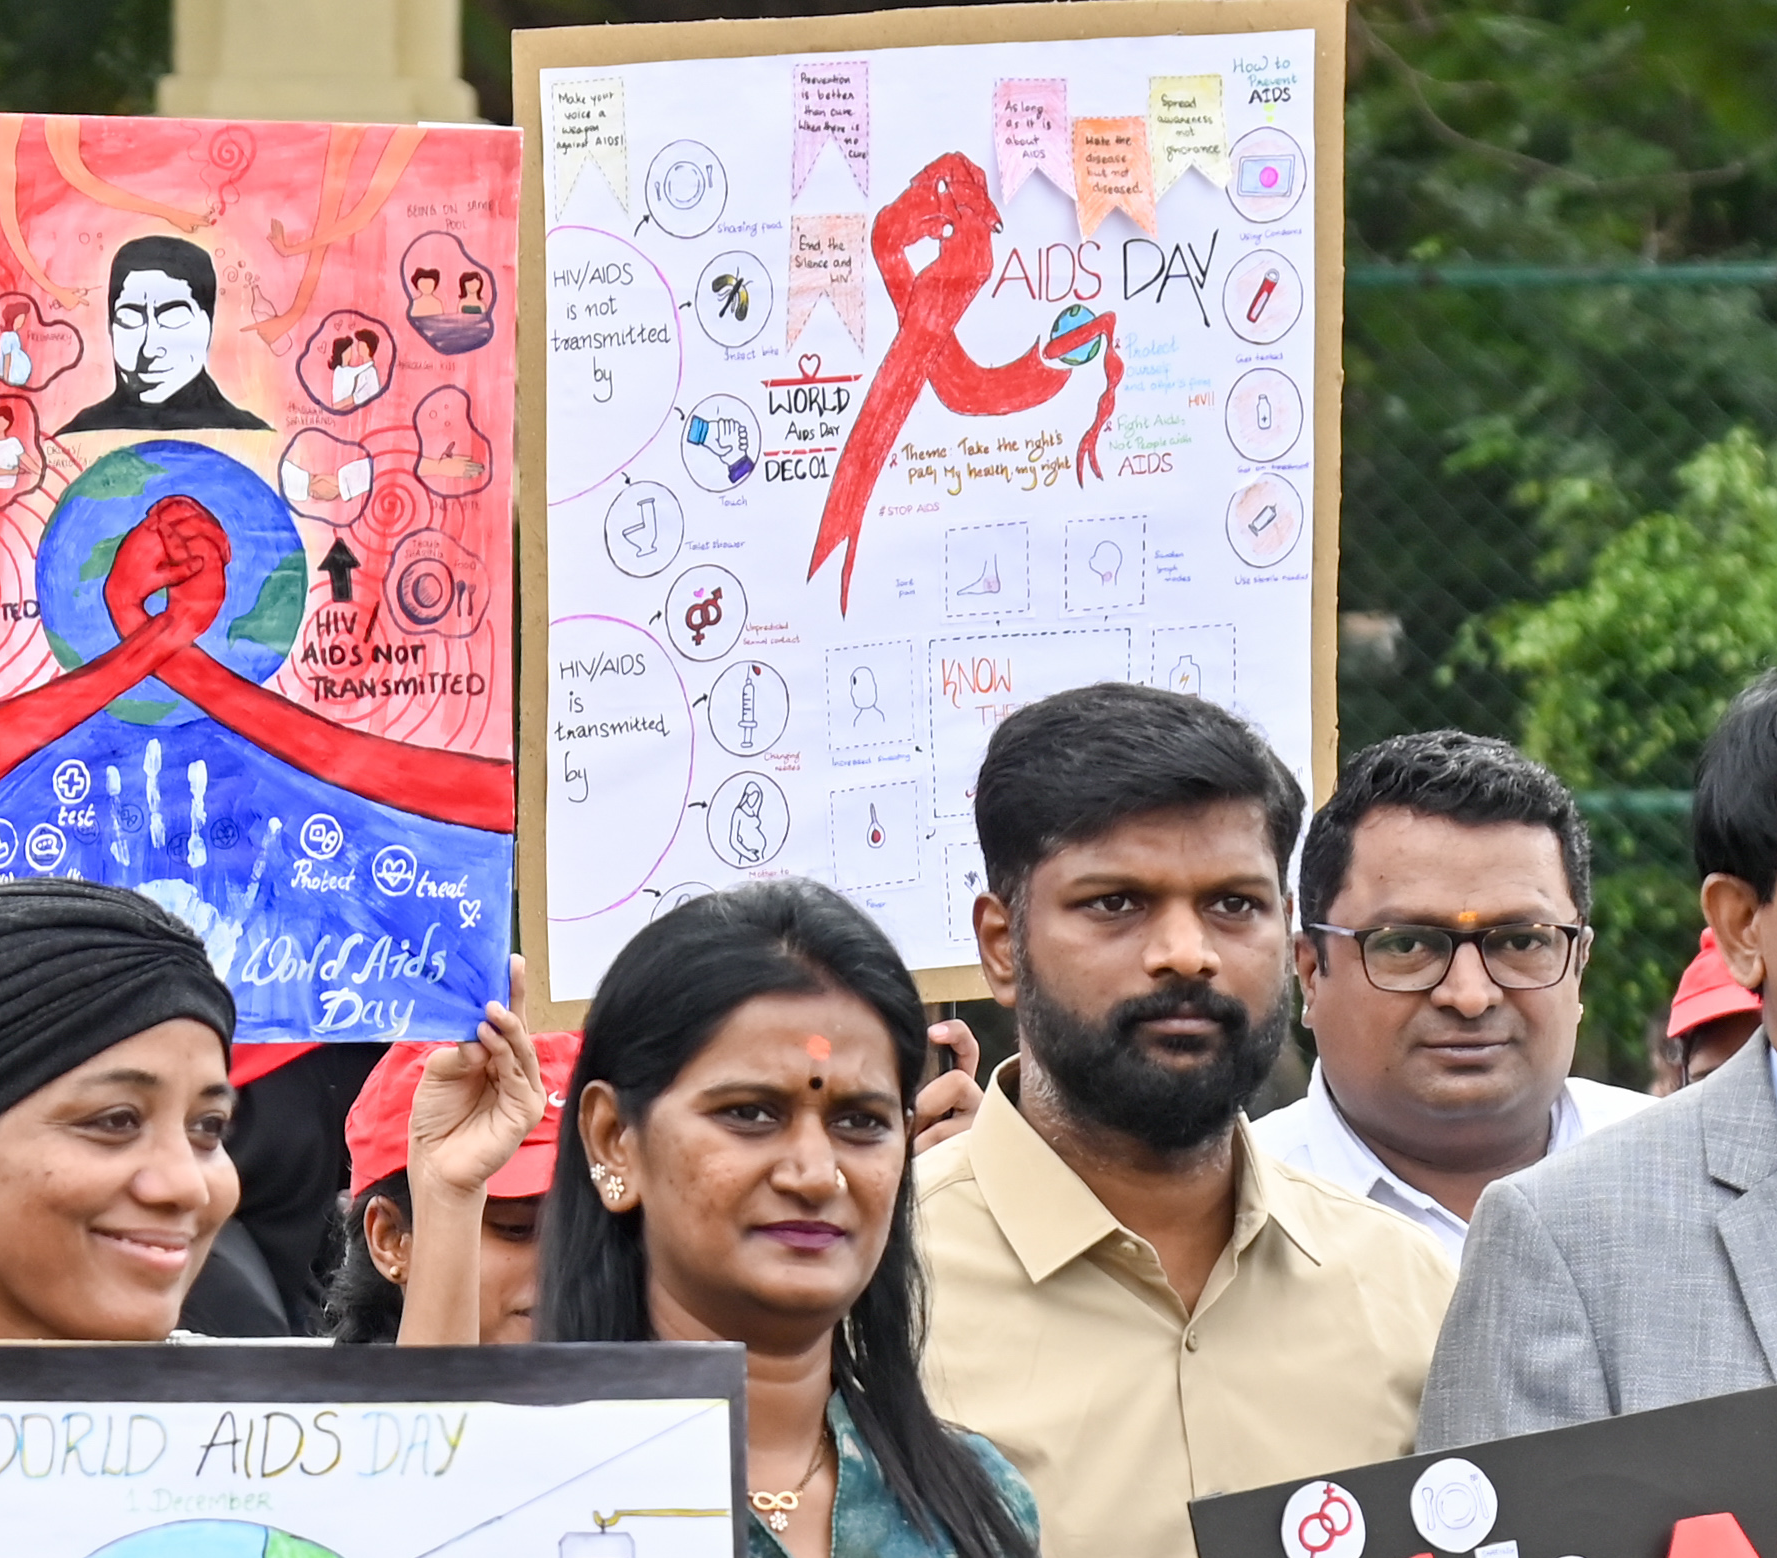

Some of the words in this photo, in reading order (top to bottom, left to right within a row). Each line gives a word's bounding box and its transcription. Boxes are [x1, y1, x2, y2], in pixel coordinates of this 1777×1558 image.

[1232, 55, 1268, 74] How
[1248, 87, 1292, 104] AIDS
[1022, 149, 1046, 159] AIDS
[553, 260, 634, 291] HIV/AIDS
[991, 240, 1102, 303] AIDS
[1122, 228, 1220, 328] DAY
[566, 302, 577, 318] is
[585, 295, 618, 318] not
[550, 323, 671, 352] transmitted
[592, 356, 614, 403] by
[769, 386, 850, 417] WORLD
[957, 436, 990, 456] Take
[997, 437, 1019, 452] the
[764, 459, 807, 482] DEC
[1041, 455, 1072, 488] right
[1117, 452, 1174, 477] AIDS
[317, 610, 358, 637] HIV
[301, 642, 363, 666] AIDS
[559, 651, 646, 681] HIV/AIDS
[941, 656, 1013, 709] KNOW
[569, 691, 585, 713] is
[554, 714, 671, 742] transmitted
[564, 751, 589, 803] by
[58, 803, 96, 827] test
[291, 858, 356, 892] Protect
[416, 871, 468, 898] treat
[241, 933, 364, 986] World
[311, 987, 416, 1037] Day
[196, 1410, 342, 1479] AIDS
[356, 1410, 468, 1479] DAY
